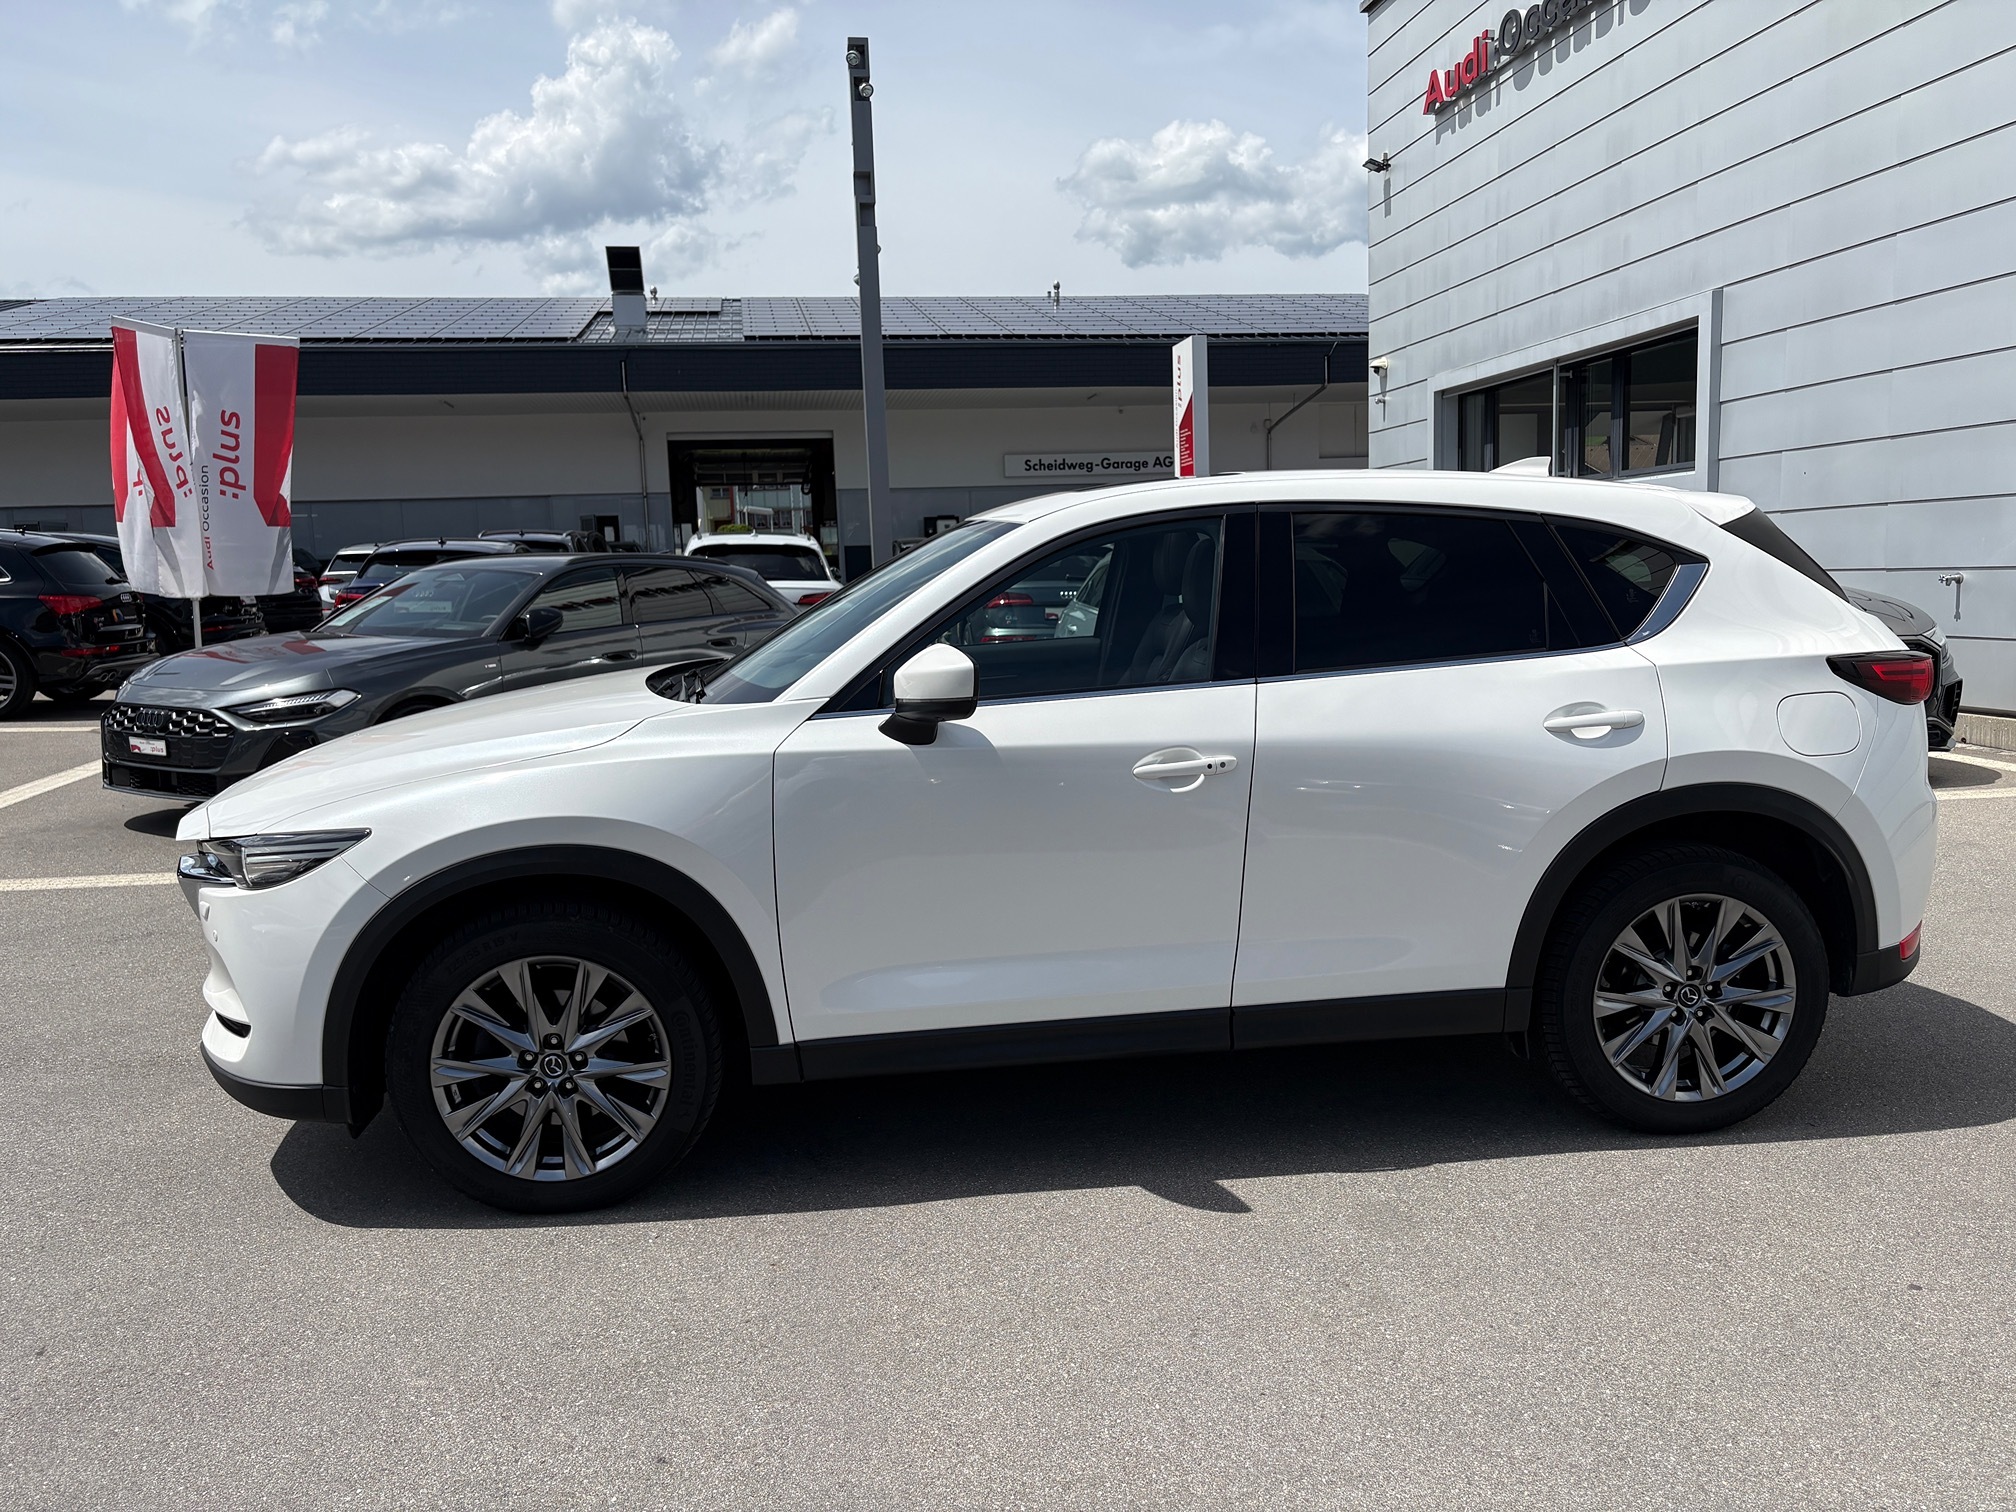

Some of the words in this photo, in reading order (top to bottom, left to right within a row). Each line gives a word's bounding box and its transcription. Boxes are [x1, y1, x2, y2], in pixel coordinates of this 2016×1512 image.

[1423, 29, 1491, 116] Audi
[1024, 457, 1149, 473] Scheidweg-Garage
[1153, 455, 1174, 469] AG
[204, 536, 214, 570] Audi
